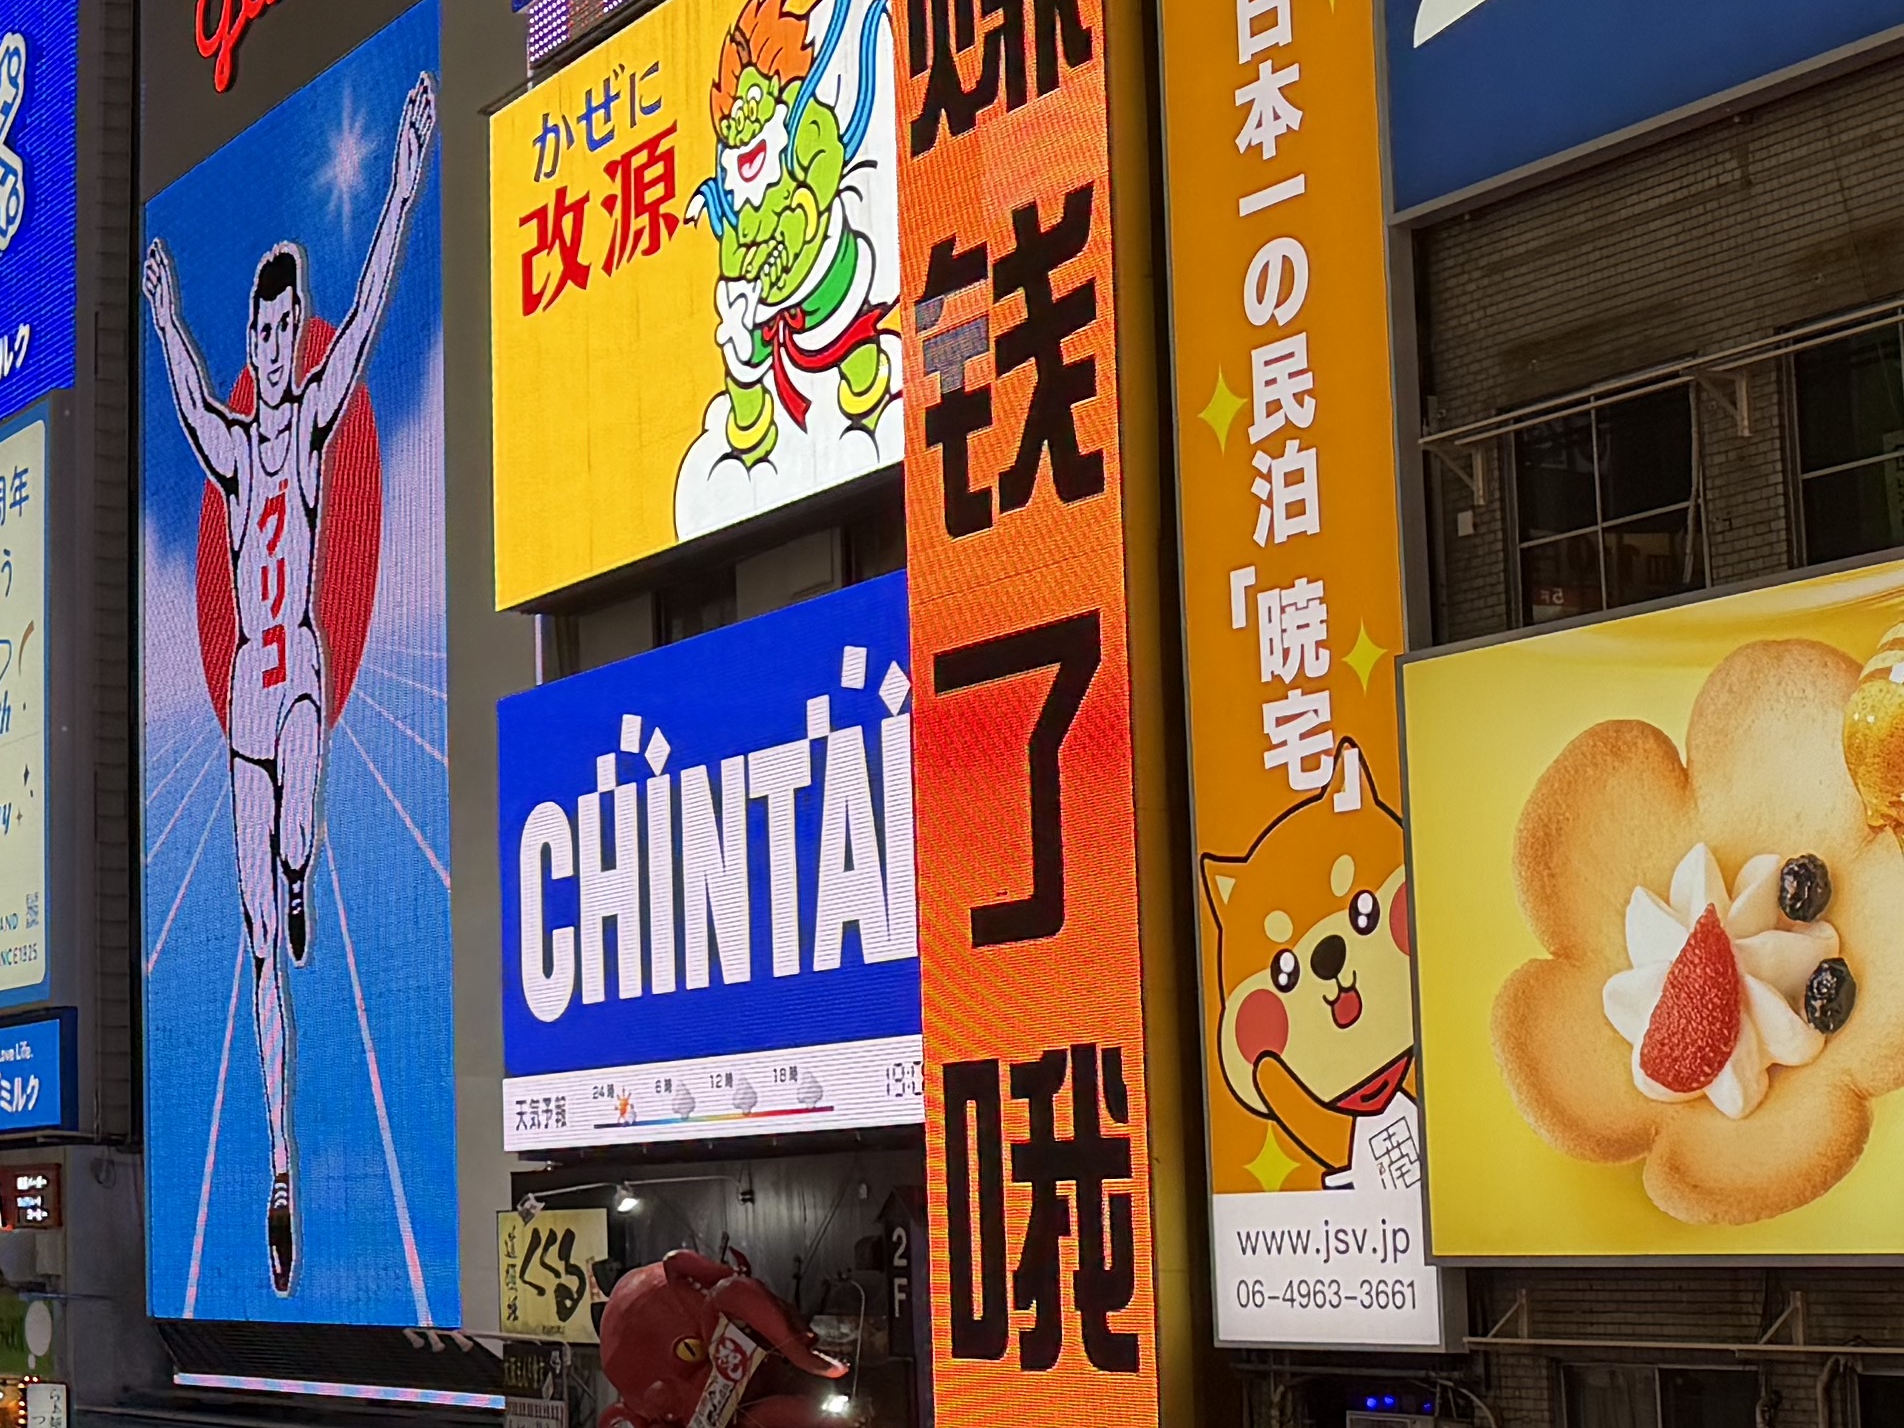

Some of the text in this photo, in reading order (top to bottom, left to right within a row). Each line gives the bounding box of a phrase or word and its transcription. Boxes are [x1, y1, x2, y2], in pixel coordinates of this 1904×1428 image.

[531, 59, 664, 184] かぜに
[518, 115, 680, 318] 改源
[255, 478, 290, 692] グリコ
[1236, 1218, 1412, 1264] www.jsv.jp
[1236, 1278, 1419, 1312] 06-4963-3661
